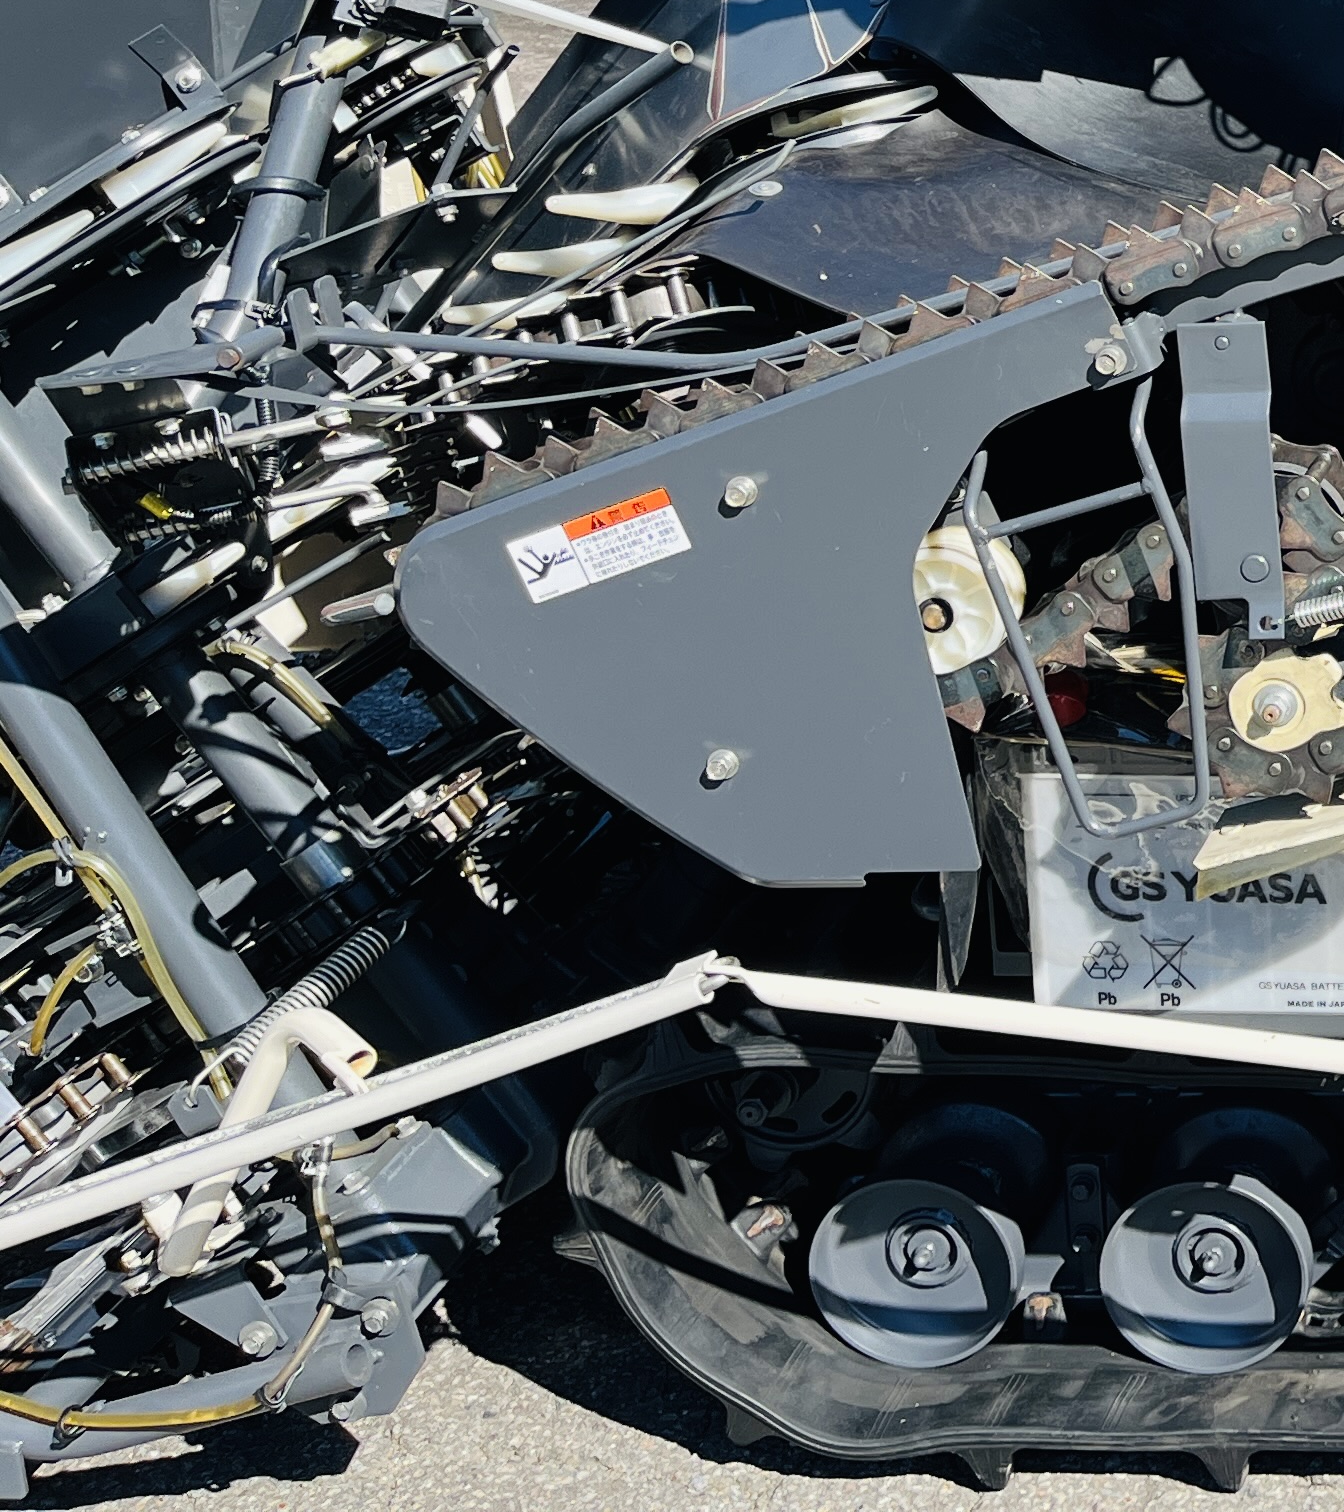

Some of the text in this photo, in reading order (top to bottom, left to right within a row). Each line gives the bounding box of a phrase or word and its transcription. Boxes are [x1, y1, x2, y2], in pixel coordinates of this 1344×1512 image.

[1098, 992, 1117, 1005] Pb
[1160, 993, 1180, 1006] Pb
[1287, 1000, 1314, 1008] MADE
[1316, 1000, 1326, 1008] IN
